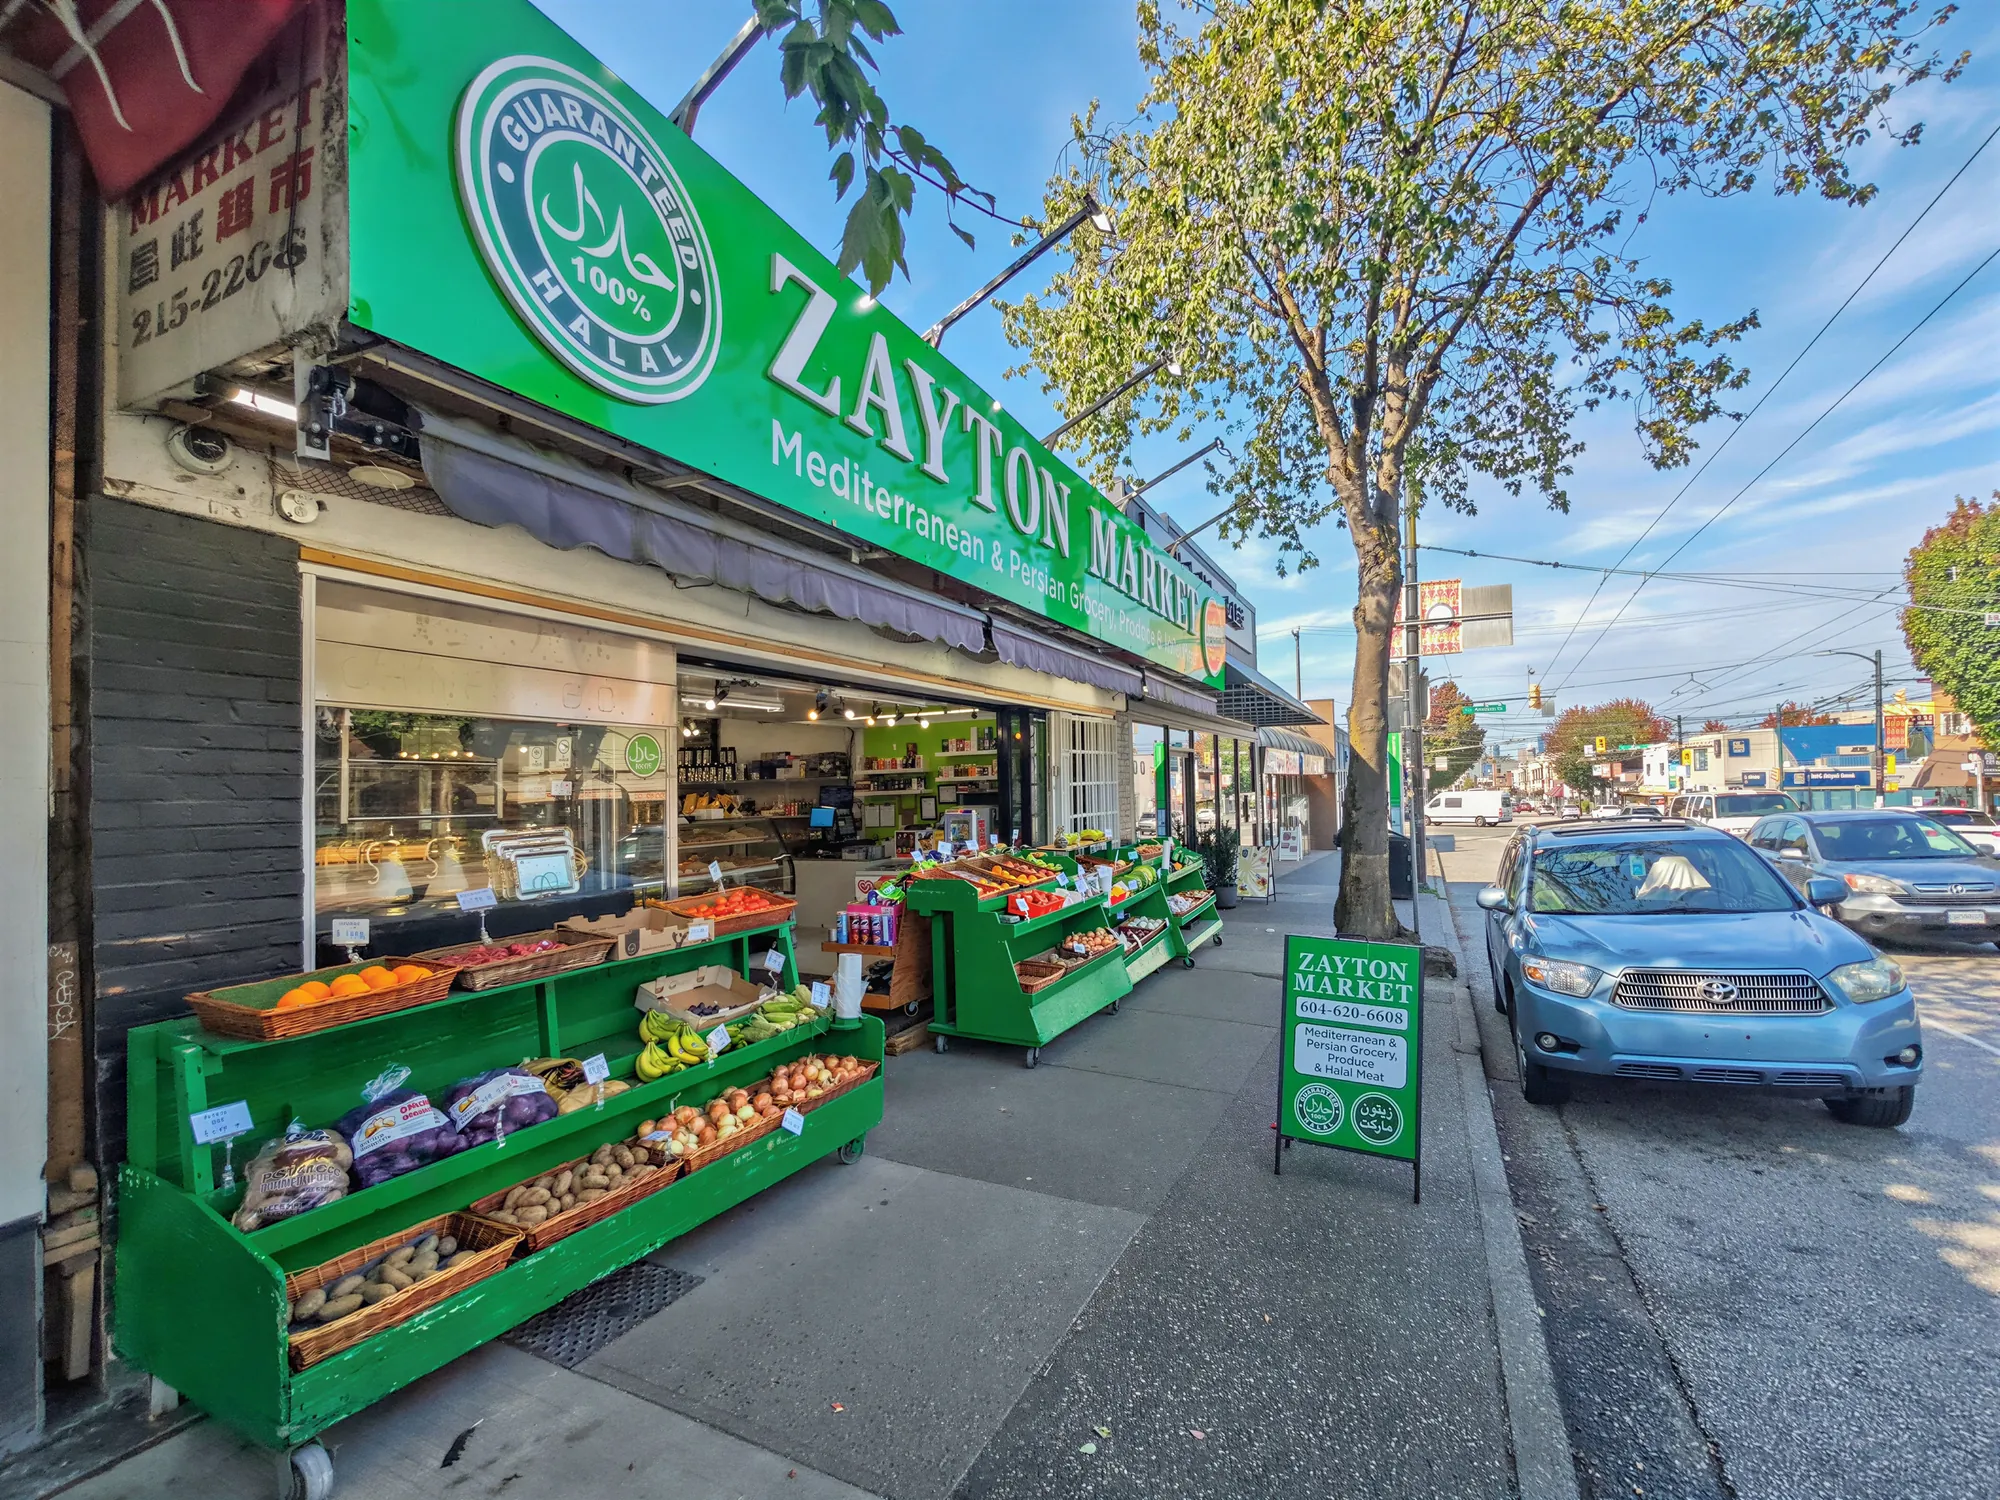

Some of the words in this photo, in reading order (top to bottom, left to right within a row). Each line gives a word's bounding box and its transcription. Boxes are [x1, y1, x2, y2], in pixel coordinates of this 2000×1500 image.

[130, 78, 322, 237] MARKET
[500, 93, 699, 270] GUARANTEED
[541, 161, 677, 293] حلال
[570, 255, 652, 322] 100%
[531, 267, 684, 373] HALAL
[766, 251, 1071, 558] ZAYTON
[1087, 506, 1200, 636] MARKET
[772, 418, 985, 564] Mediterranean
[990, 540, 1004, 573] &
[1010, 549, 1065, 604] Persian
[1069, 582, 1118, 632] Grocery,
[1298, 952, 1409, 981] ZAYTON
[1293, 973, 1413, 1004] MARKET
[1300, 1001, 1404, 1024] 604-620-6608
[1304, 1026, 1386, 1046] Mediterranean
[1388, 1037, 1398, 1048] &
[1306, 1038, 1347, 1053] Persian
[1350, 1045, 1398, 1062] Grocery,
[1327, 1053, 1375, 1069] Produce
[1314, 1062, 1322, 1073] &
[1325, 1064, 1353, 1077] Halal
[1356, 1069, 1385, 1082] Meat
[1300, 1087, 1339, 1108] GUARANTEED
[1305, 1097, 1333, 1114] حلال
[1310, 1113, 1328, 1121] 100%
[1360, 1103, 1394, 1120] زيتون
[1303, 1117, 1335, 1130] HALAL
[1359, 1119, 1394, 1135] ماركت
